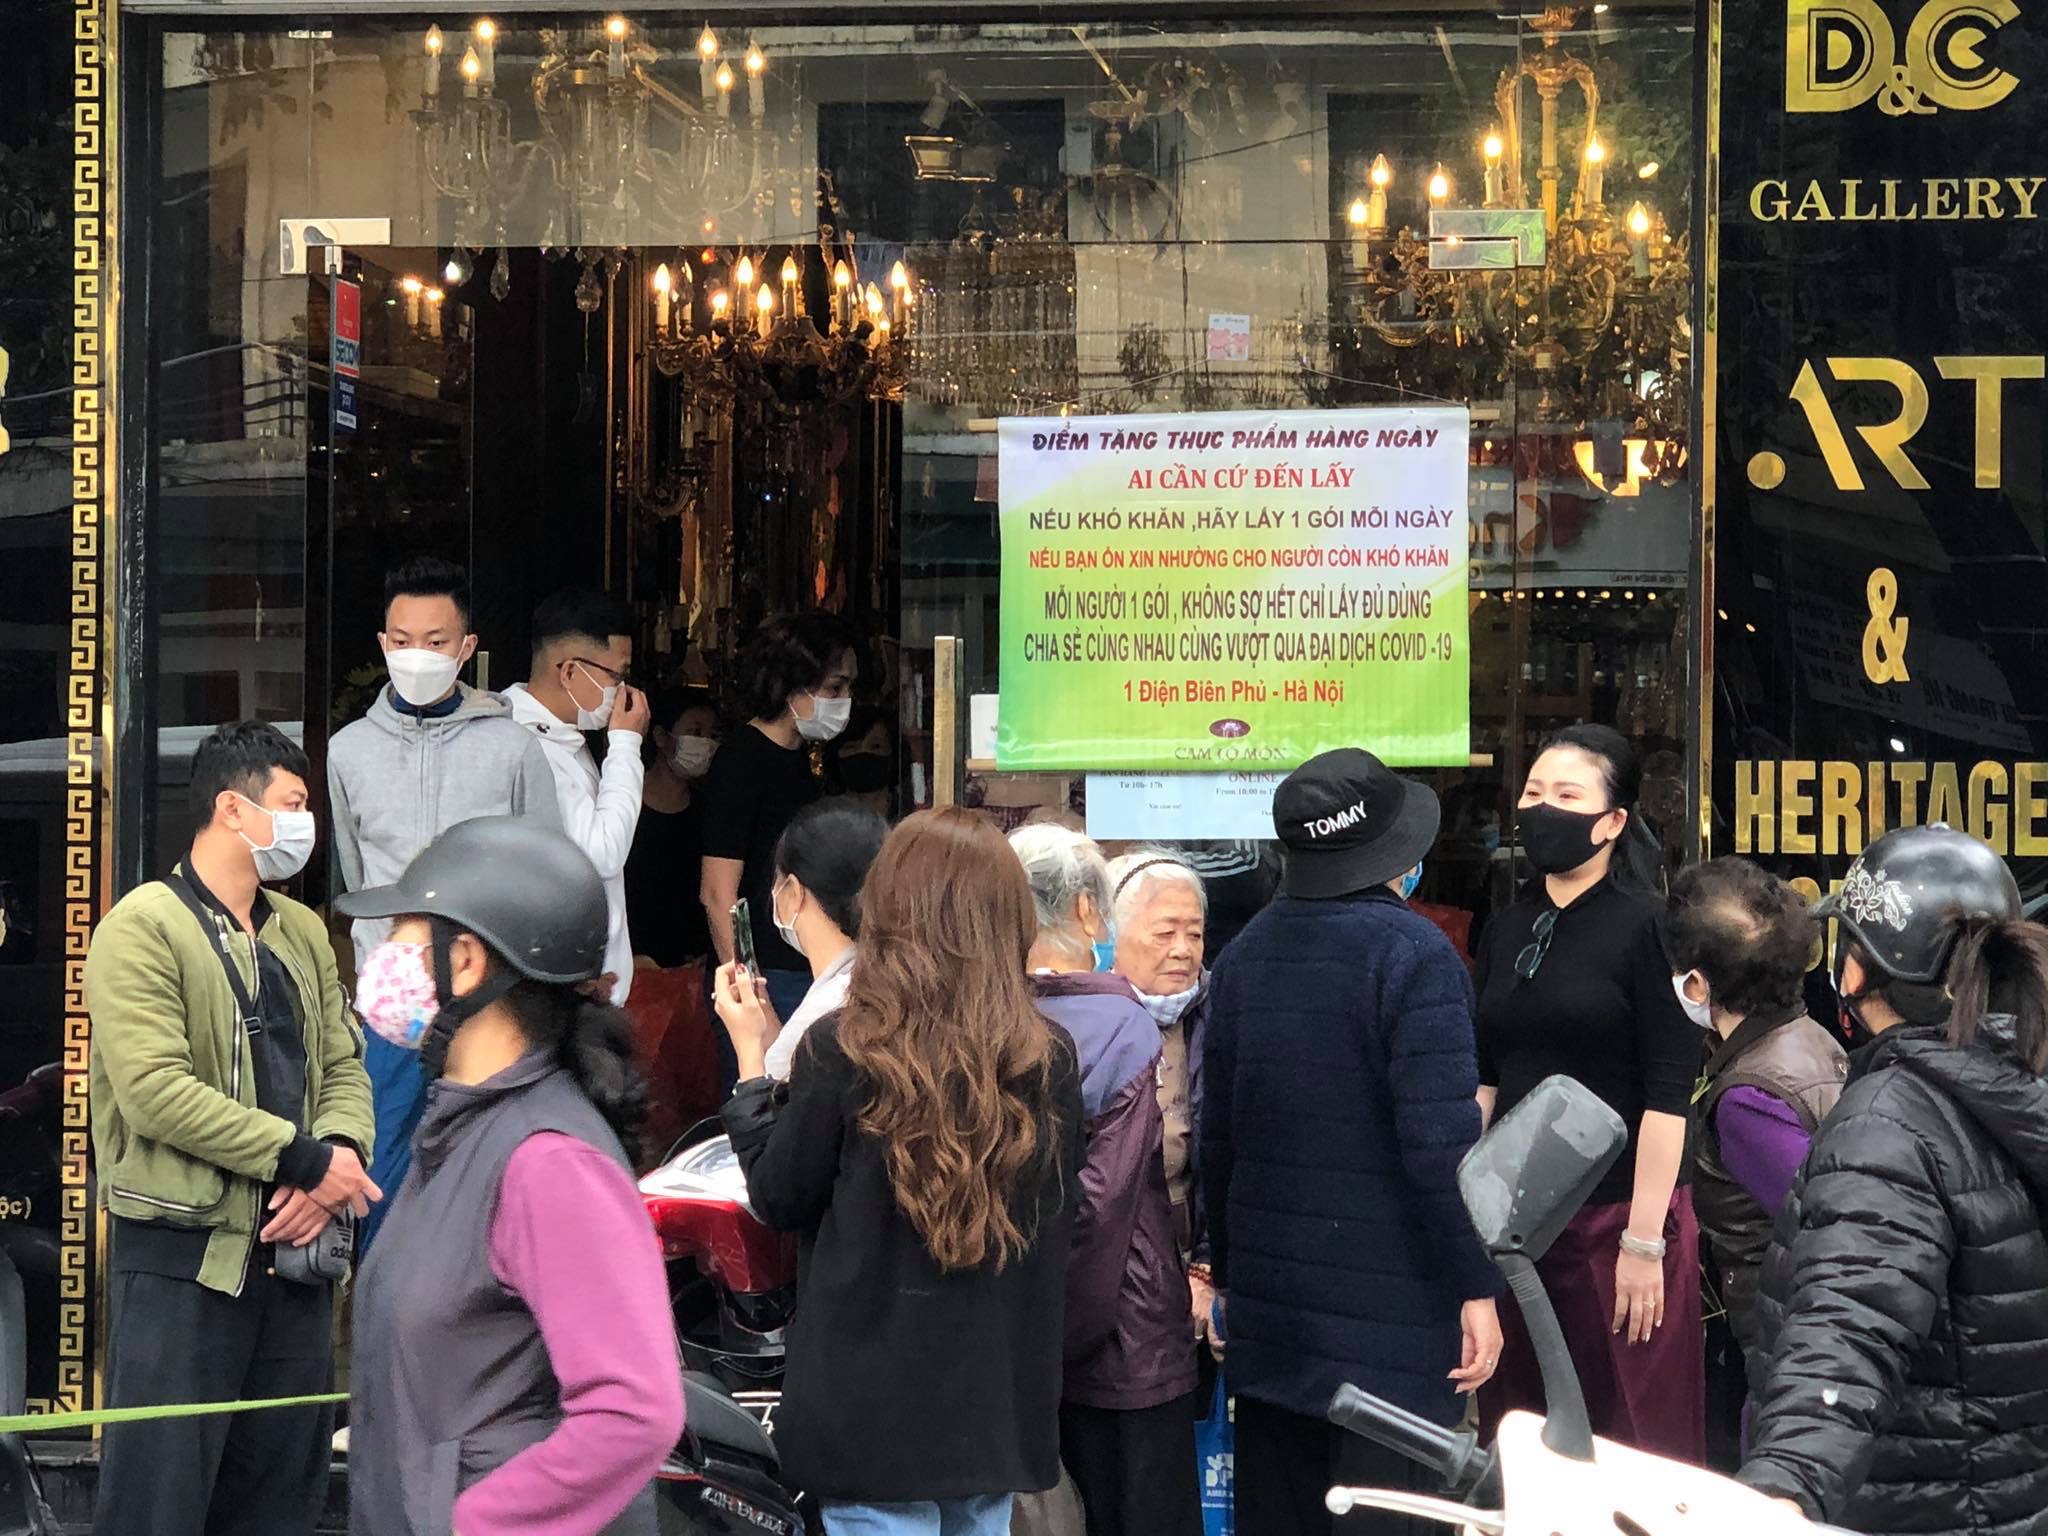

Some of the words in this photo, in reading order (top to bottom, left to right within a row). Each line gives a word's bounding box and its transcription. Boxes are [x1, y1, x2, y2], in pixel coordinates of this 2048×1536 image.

[1749, 177, 2046, 222] GALLERY
[1032, 421, 1089, 451] ĐIỂM
[1100, 428, 1158, 454] TẶNG
[1168, 430, 1225, 453] THỰC
[1232, 422, 1298, 449] PHẨM
[1306, 425, 1370, 449] HÀNG
[1376, 425, 1440, 448] NGÀY
[1128, 469, 1153, 490] AI
[1159, 463, 1207, 489] CẦN
[1214, 463, 1249, 489] CỨ
[1254, 462, 1304, 489] ĐẾN
[1311, 461, 1355, 488] LẤY
[1078, 507, 1122, 530] KHÓ
[1128, 507, 1185, 530] KHĂN
[1291, 510, 1299, 529] 1
[1308, 505, 1344, 529] GÓI
[1351, 505, 1388, 529] MỖI
[1395, 505, 1454, 529] NGÀY
[1065, 549, 1098, 573] BẠN
[1129, 550, 1154, 568] XIN
[1159, 545, 1228, 568] NHƯỜNG
[1232, 549, 1267, 567] CHO
[1271, 545, 1323, 567] NGƯỜI
[1328, 545, 1361, 567] CÒN
[1367, 544, 1400, 567] KHÓ
[1405, 545, 1449, 567] KHĂN
[1045, 584, 1072, 620] MỖI
[1076, 583, 1126, 620] NGƯỜI
[1130, 590, 1137, 619] 1
[1143, 583, 1169, 620] GÓI
[1182, 583, 1236, 619] KHÔNG
[1240, 590, 1263, 626] SỢ
[1266, 583, 1296, 619] HẾT
[1300, 583, 1325, 619] CHỈ
[1329, 582, 1359, 619] LẤY
[1362, 583, 1384, 619] ĐỦ
[1388, 582, 1432, 619] DÙNG
[1862, 567, 1911, 684] &
[1024, 633, 1060, 662] CHIA
[1063, 626, 1082, 662] SẺ
[1086, 625, 1129, 662] CÙNG
[1134, 632, 1175, 662] NHAU
[1179, 625, 1222, 662] CÙNG
[1226, 632, 1270, 669] VƯỢT
[1274, 631, 1307, 663] QUA
[1310, 632, 1335, 668] ĐẠI
[1339, 632, 1376, 668] DỊCH
[1380, 631, 1427, 662] COVID
[1124, 680, 1132, 702] 1
[1139, 680, 1179, 708] Điện
[1185, 680, 1226, 702] Biên
[1231, 679, 1267, 702] Phủ
[1284, 680, 1308, 702] Hà
[1314, 680, 1344, 708] Nội
[1303, 800, 1367, 839] TOMMY
[1734, 760, 2048, 857] HERITAGE
